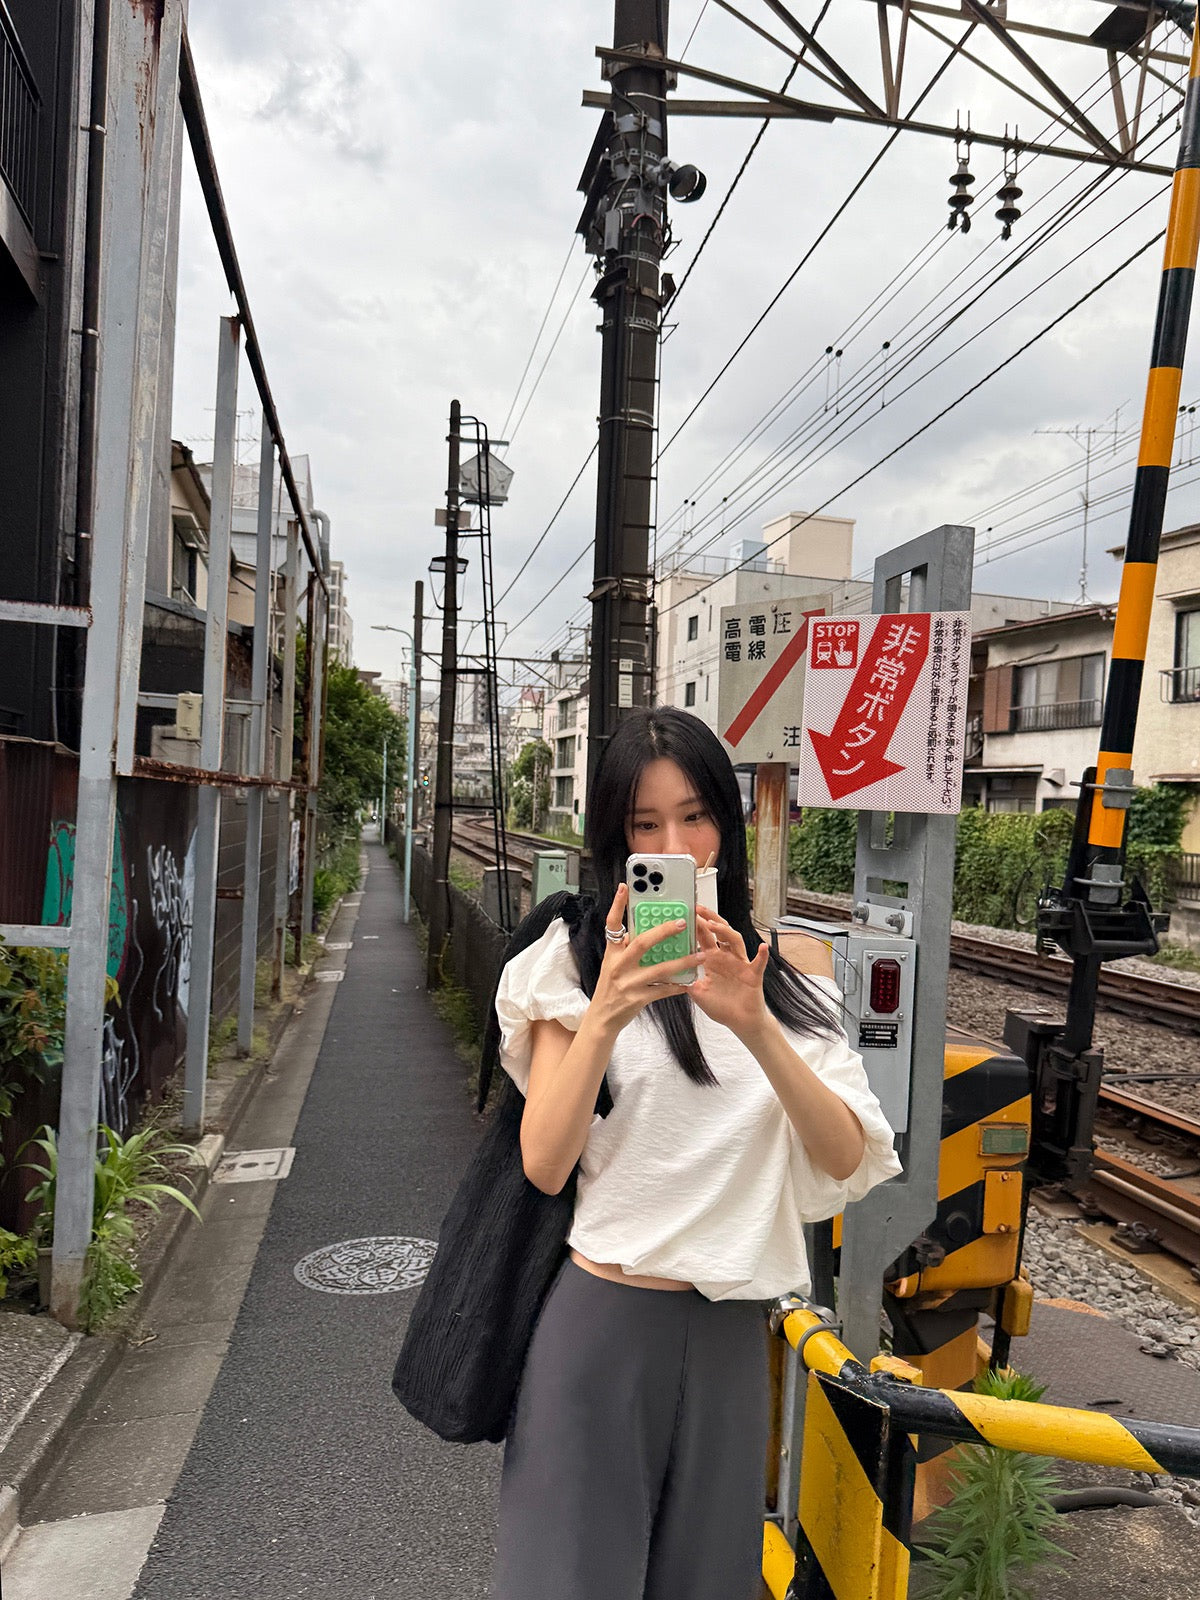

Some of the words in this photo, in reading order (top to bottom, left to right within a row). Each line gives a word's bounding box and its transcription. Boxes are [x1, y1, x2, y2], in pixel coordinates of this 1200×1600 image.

[725, 611, 792, 639] 高電圧
[816, 624, 857, 638] STOP
[725, 640, 766, 662] 電線
[832, 623, 922, 776] 非常ボタン
